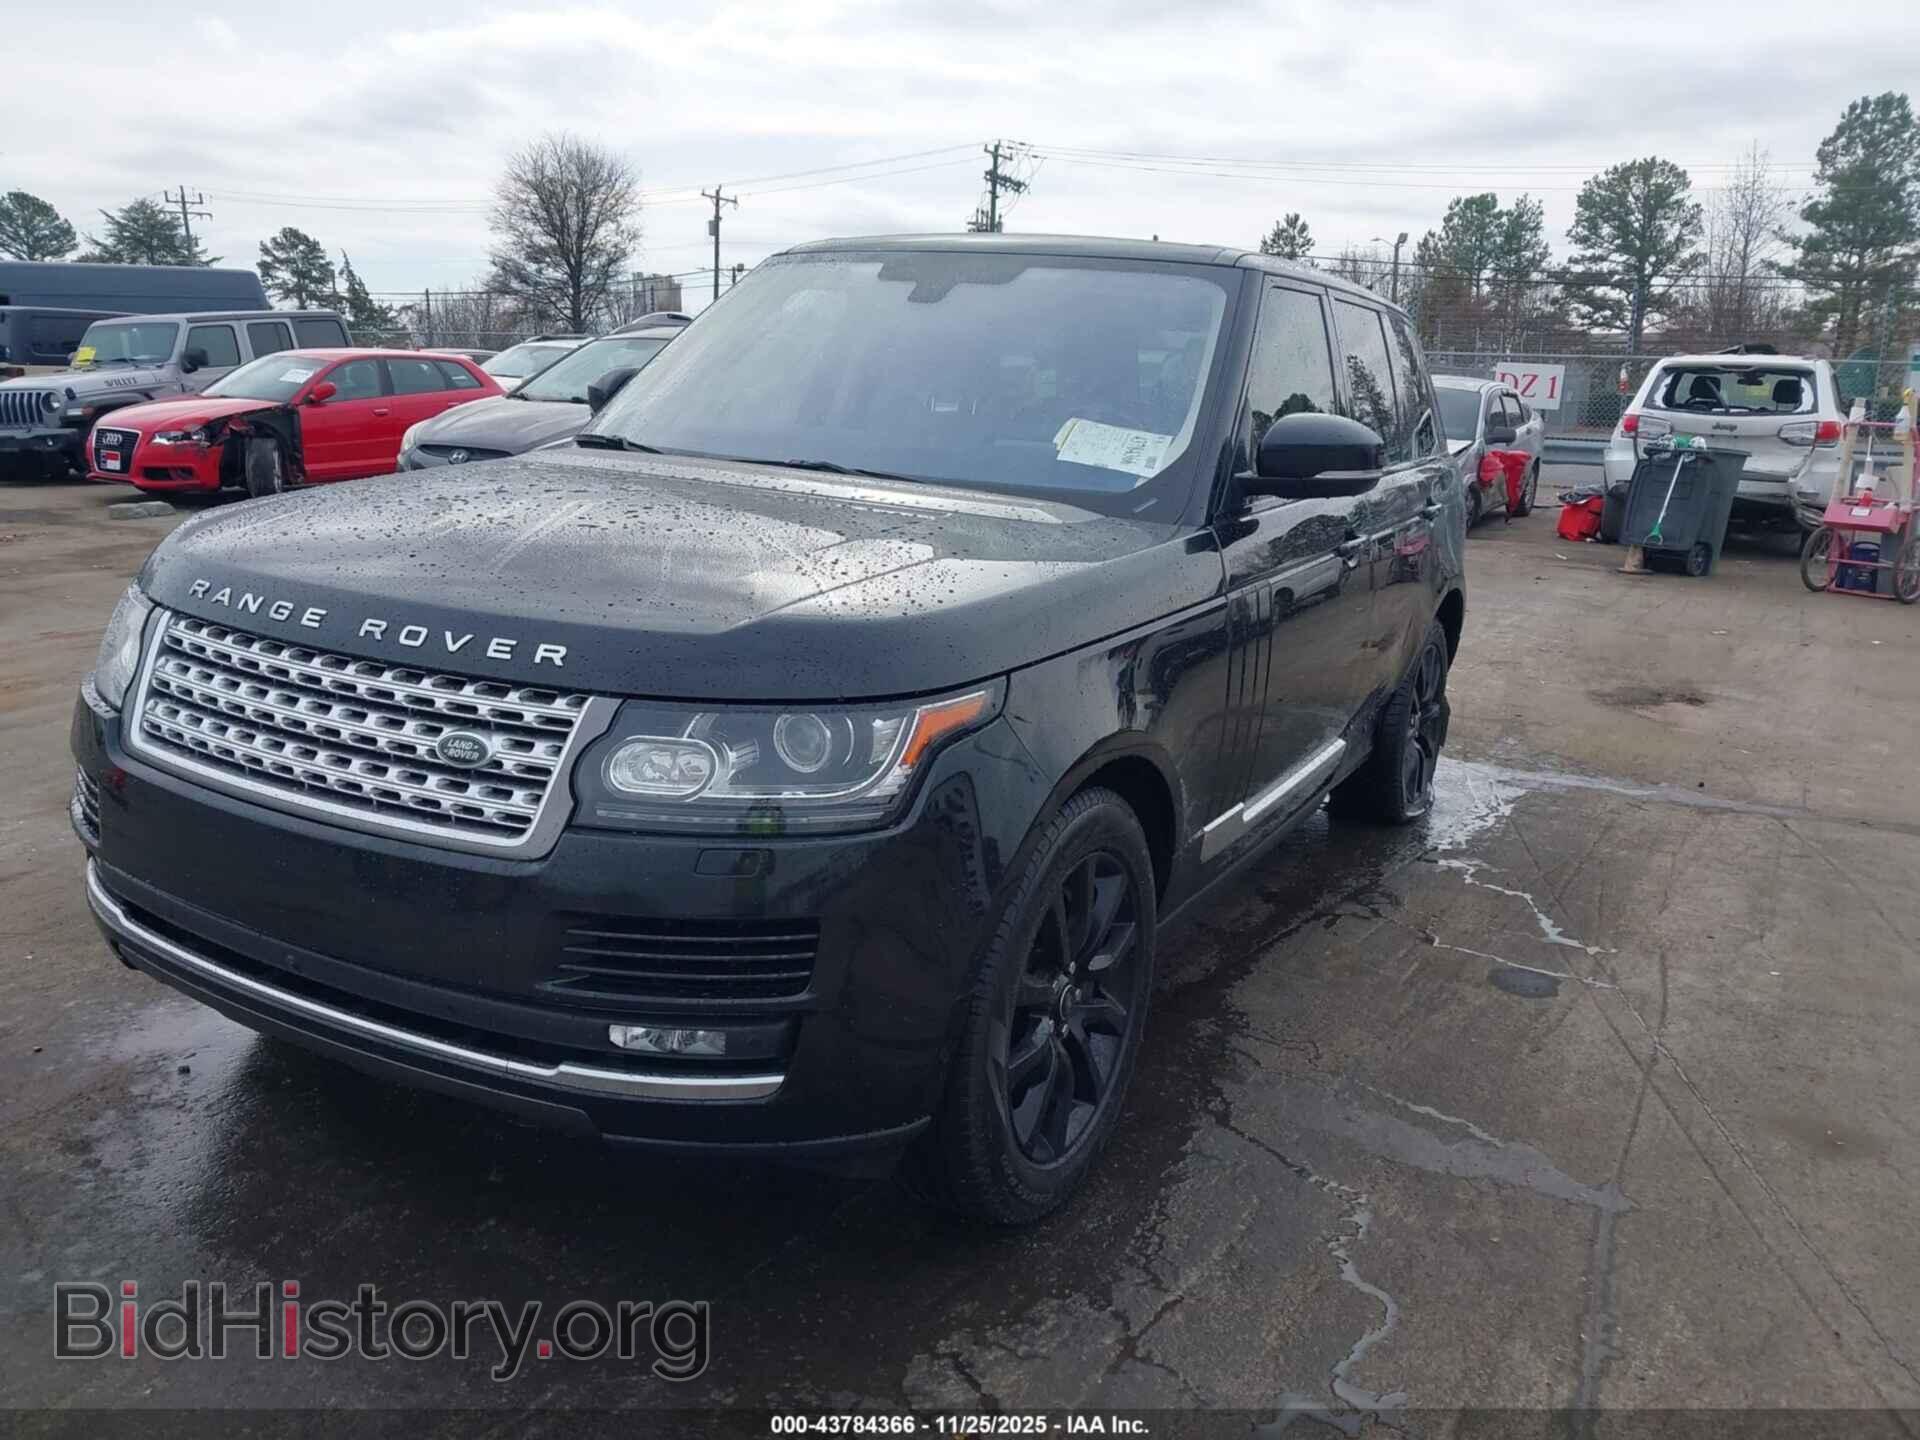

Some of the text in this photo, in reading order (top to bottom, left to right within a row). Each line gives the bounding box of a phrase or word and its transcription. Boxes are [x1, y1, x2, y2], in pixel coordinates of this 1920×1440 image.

[1546, 375, 1558, 399] 1
[188, 578, 568, 667] RANGE ROVER
[447, 738, 473, 750] LAND
[447, 748, 480, 761] ROVER
